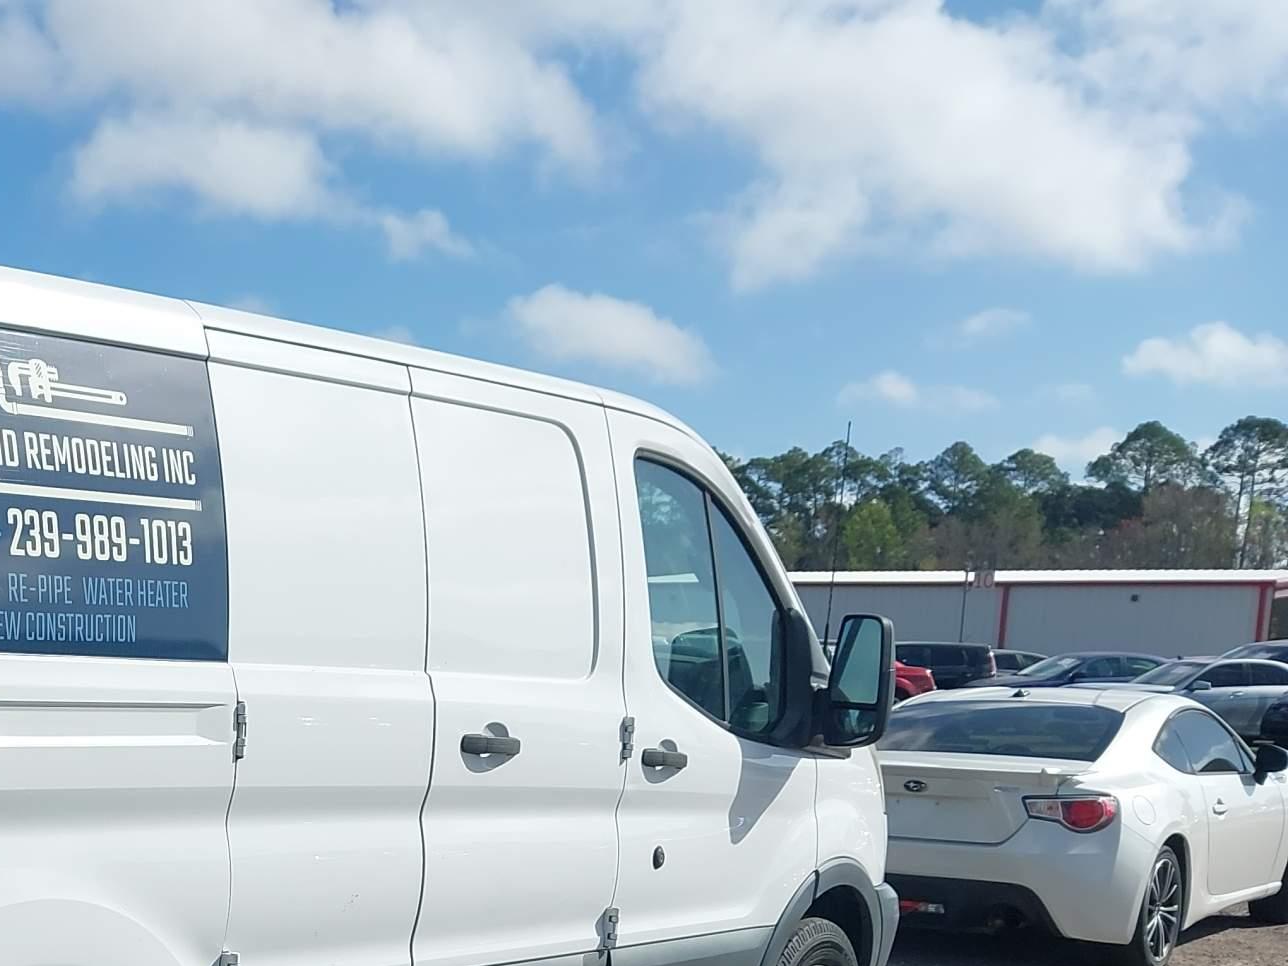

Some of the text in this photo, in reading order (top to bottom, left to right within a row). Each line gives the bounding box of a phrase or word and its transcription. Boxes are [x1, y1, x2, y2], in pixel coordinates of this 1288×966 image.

[26, 433, 156, 482] REMODELING
[164, 448, 196, 486] INC
[7, 508, 193, 566] 239-989-1013
[8, 573, 72, 604] RE-PIPE
[82, 577, 134, 607] WATER
[137, 578, 189, 608] HEATER
[26, 612, 136, 643] CONSTRUCTION
